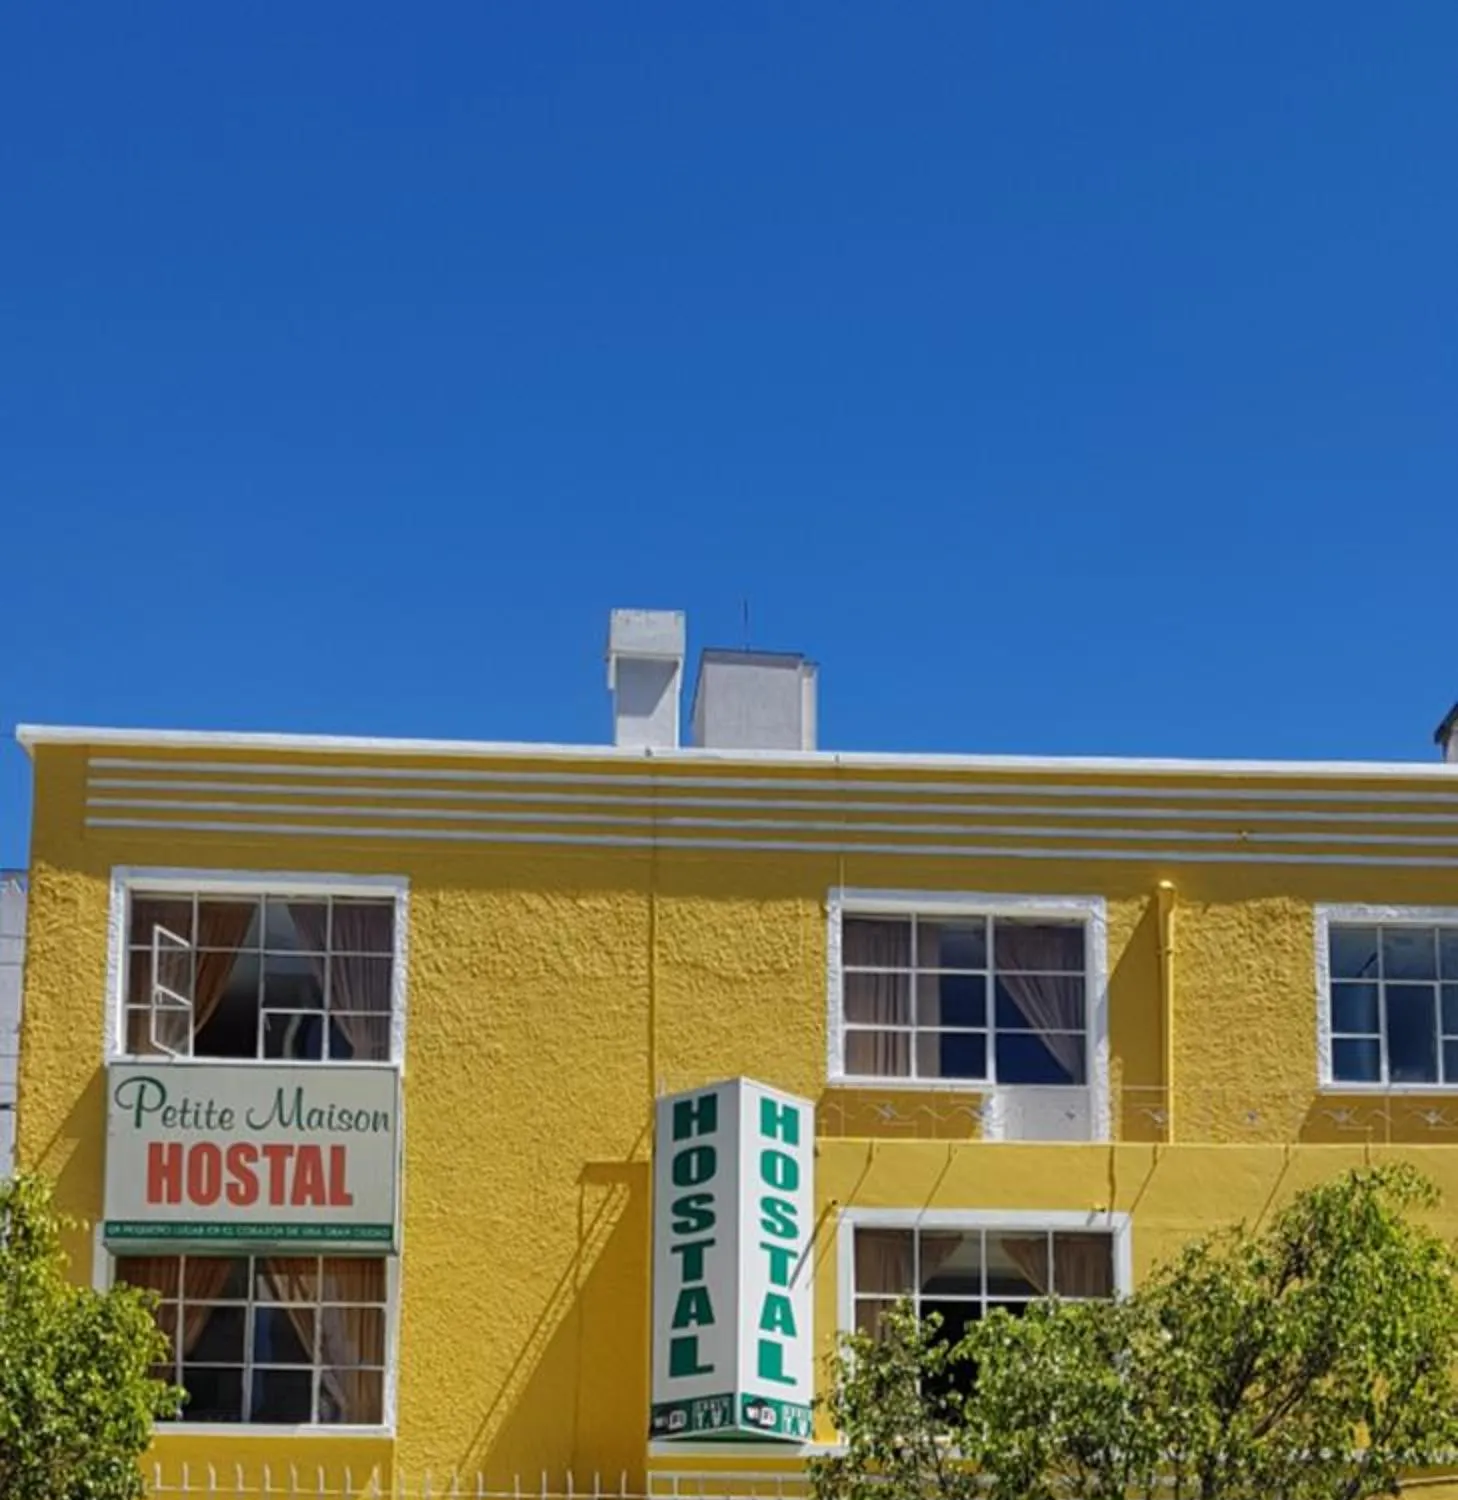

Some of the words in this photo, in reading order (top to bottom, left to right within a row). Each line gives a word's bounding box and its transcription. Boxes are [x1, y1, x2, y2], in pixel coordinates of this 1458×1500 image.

[114, 1075, 235, 1130] Petite
[245, 1086, 390, 1133] Maison
[146, 1141, 354, 1207] HOSTAL
[668, 1092, 718, 1378] HOSTAL
[757, 1096, 800, 1386] HOSTAL
